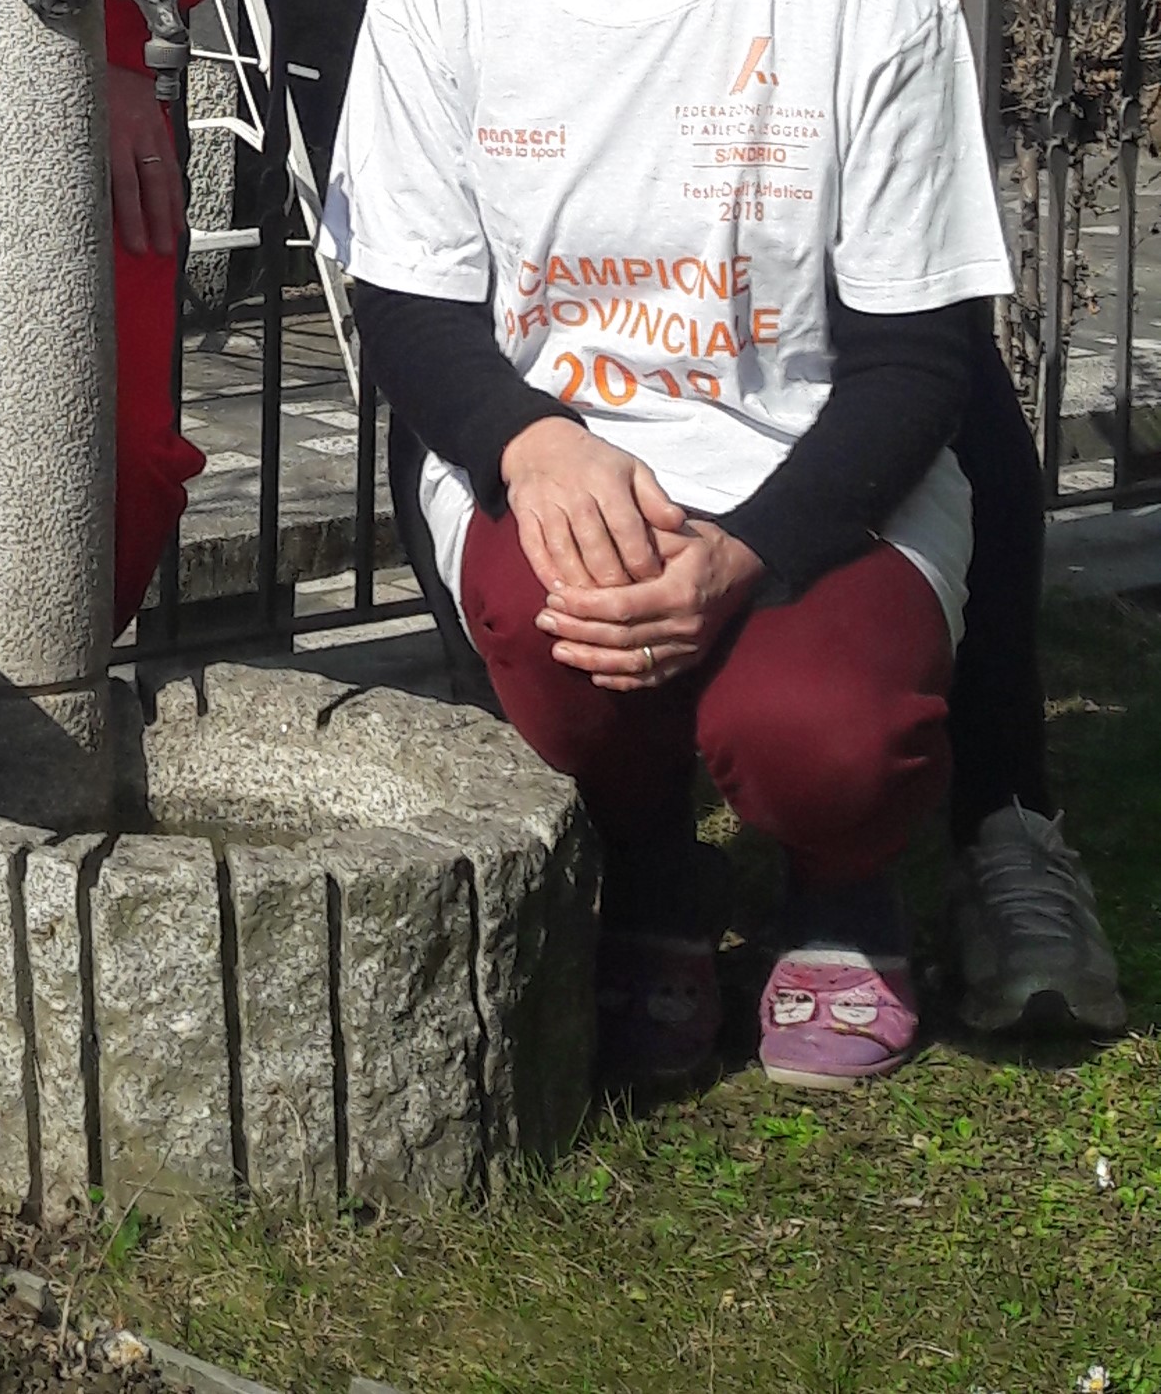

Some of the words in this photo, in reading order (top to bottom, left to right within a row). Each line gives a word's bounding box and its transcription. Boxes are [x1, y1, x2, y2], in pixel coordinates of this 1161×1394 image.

[478, 124, 566, 145] panzeri
[531, 147, 566, 162] sport
[719, 201, 765, 222] 2018
[518, 255, 753, 300] CAMPIONE
